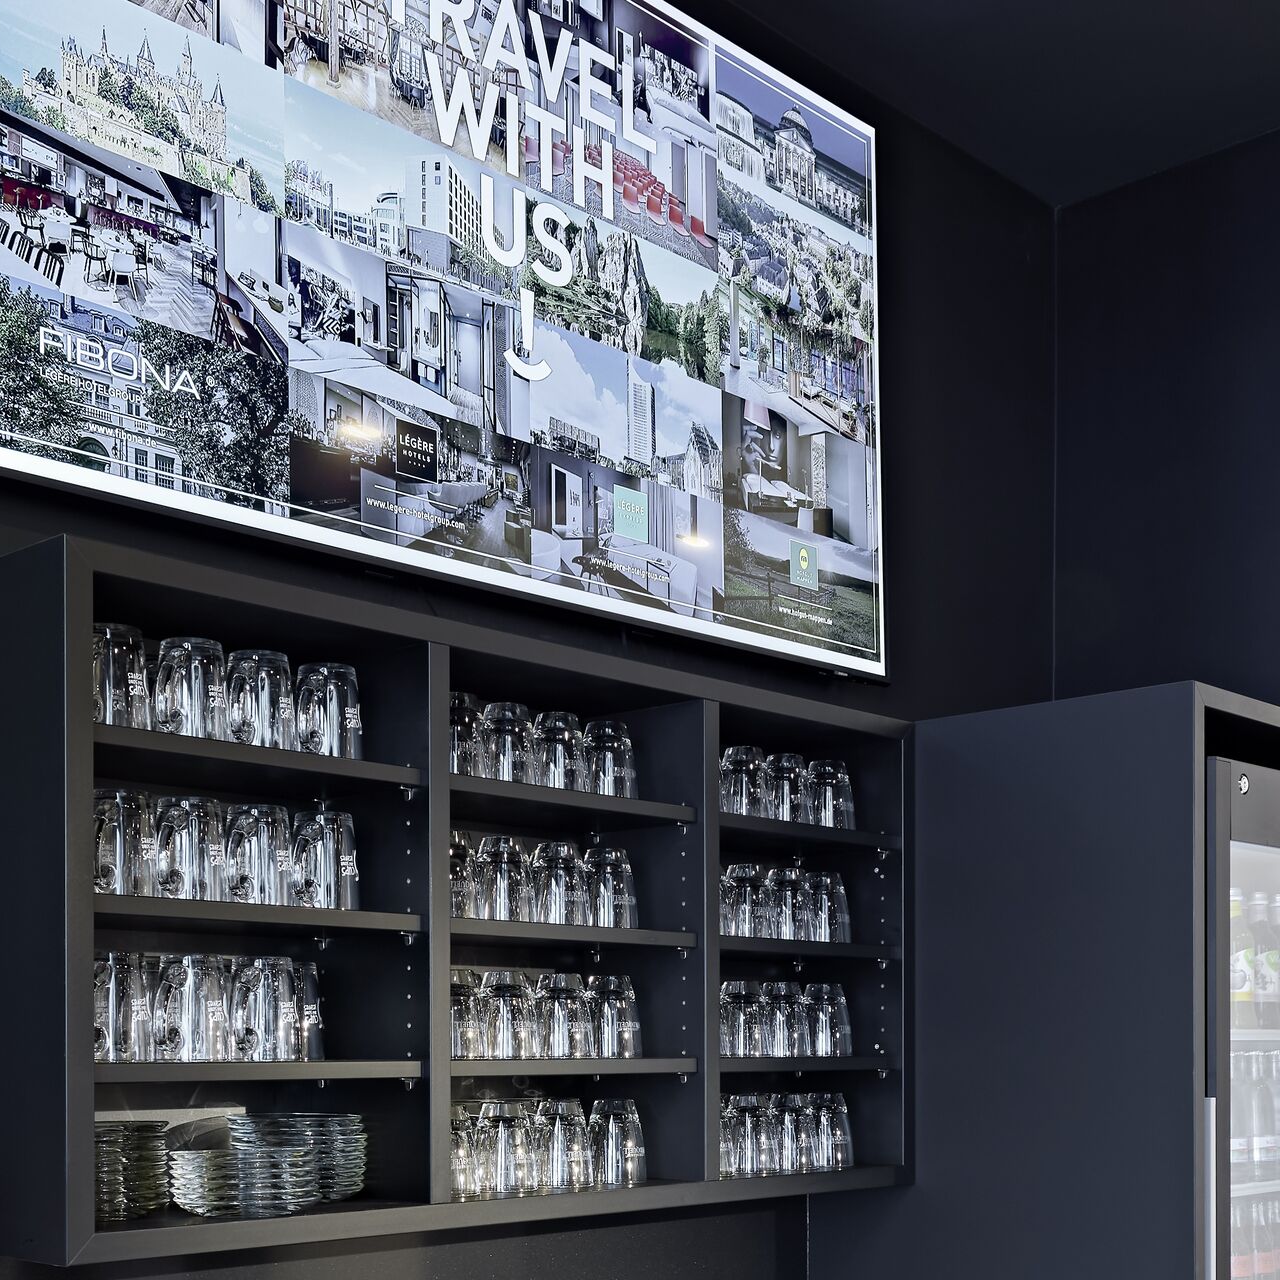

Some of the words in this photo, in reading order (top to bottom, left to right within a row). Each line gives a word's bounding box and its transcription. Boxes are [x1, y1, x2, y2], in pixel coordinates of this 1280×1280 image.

[391, 0, 656, 155] RAVEL
[425, 50, 613, 221] WITH
[480, 173, 573, 286] US
[39, 327, 200, 400] FIBONA
[88, 423, 157, 447] www.fibona.de
[399, 432, 434, 454] LÉGÈRE
[402, 450, 431, 463] HOTELS
[366, 497, 466, 530] www.legere-hotelgroup.com
